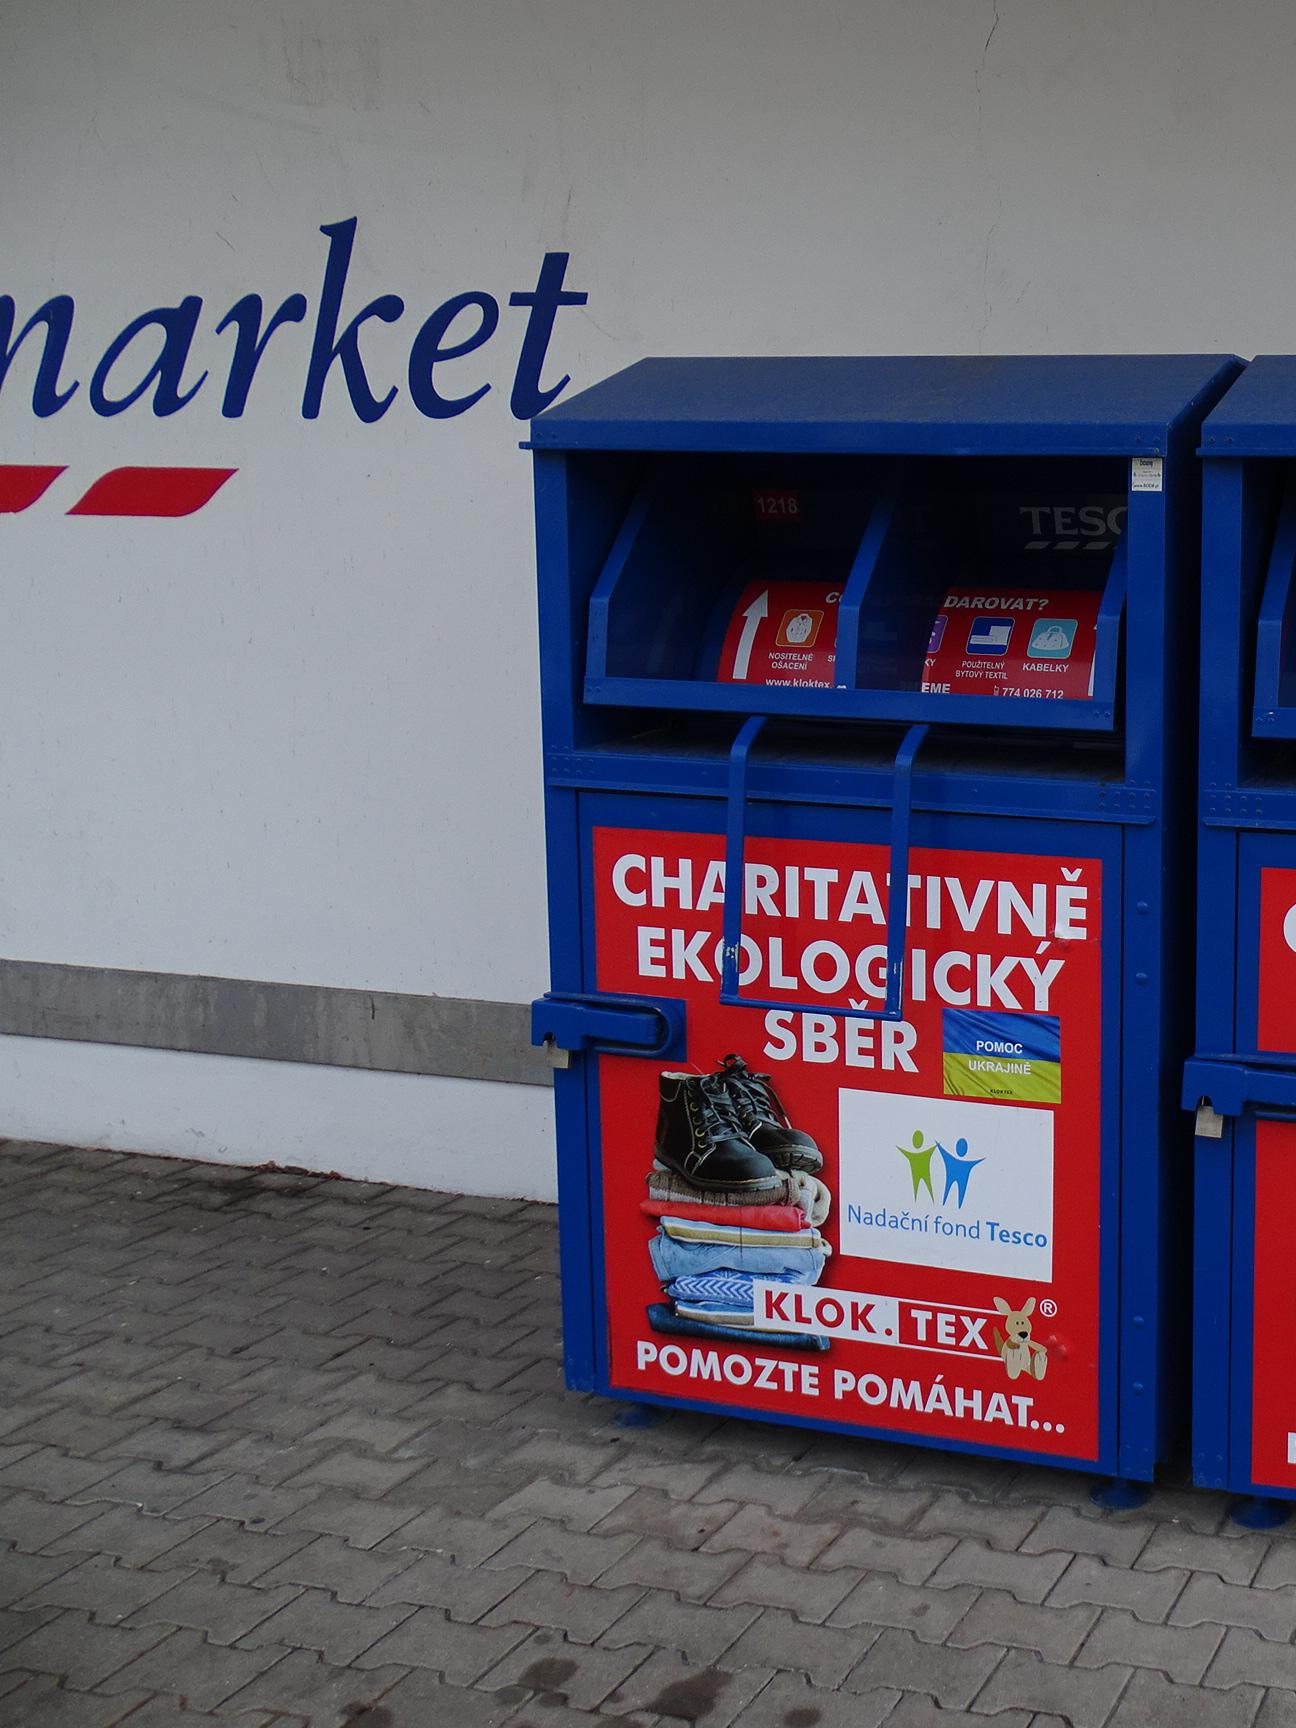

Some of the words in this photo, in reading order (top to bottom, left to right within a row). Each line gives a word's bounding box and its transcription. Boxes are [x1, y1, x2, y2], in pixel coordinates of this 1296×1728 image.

[758, 497, 798, 513] 1218
[1019, 506, 1127, 536] TESC
[944, 596, 1049, 611] DAROVAT?
[768, 652, 814, 661] NOSITELNÉ
[771, 661, 808, 670] OŠACENÍ
[961, 660, 1005, 670] POUŽITELNÝ
[1022, 662, 1069, 672] KABELKY
[985, 671, 1008, 680] TEXTIL
[1002, 687, 1021, 696] 774
[1024, 688, 1042, 698] 026
[1045, 689, 1064, 699] 712
[637, 926, 1065, 1012] EKOLOGICKÝ
[763, 998, 919, 1073] SBĚR
[976, 1040, 1023, 1054] POMOC
[968, 1060, 1031, 1075] UKRAJINĚ
[847, 1204, 930, 1232] Nadační
[934, 1214, 980, 1239] fond
[986, 1222, 1047, 1248] Tesco
[910, 1309, 989, 1350] TEX
[636, 1341, 821, 1396] POMOZTE
[834, 1369, 1065, 1433] POMÁHAT...
